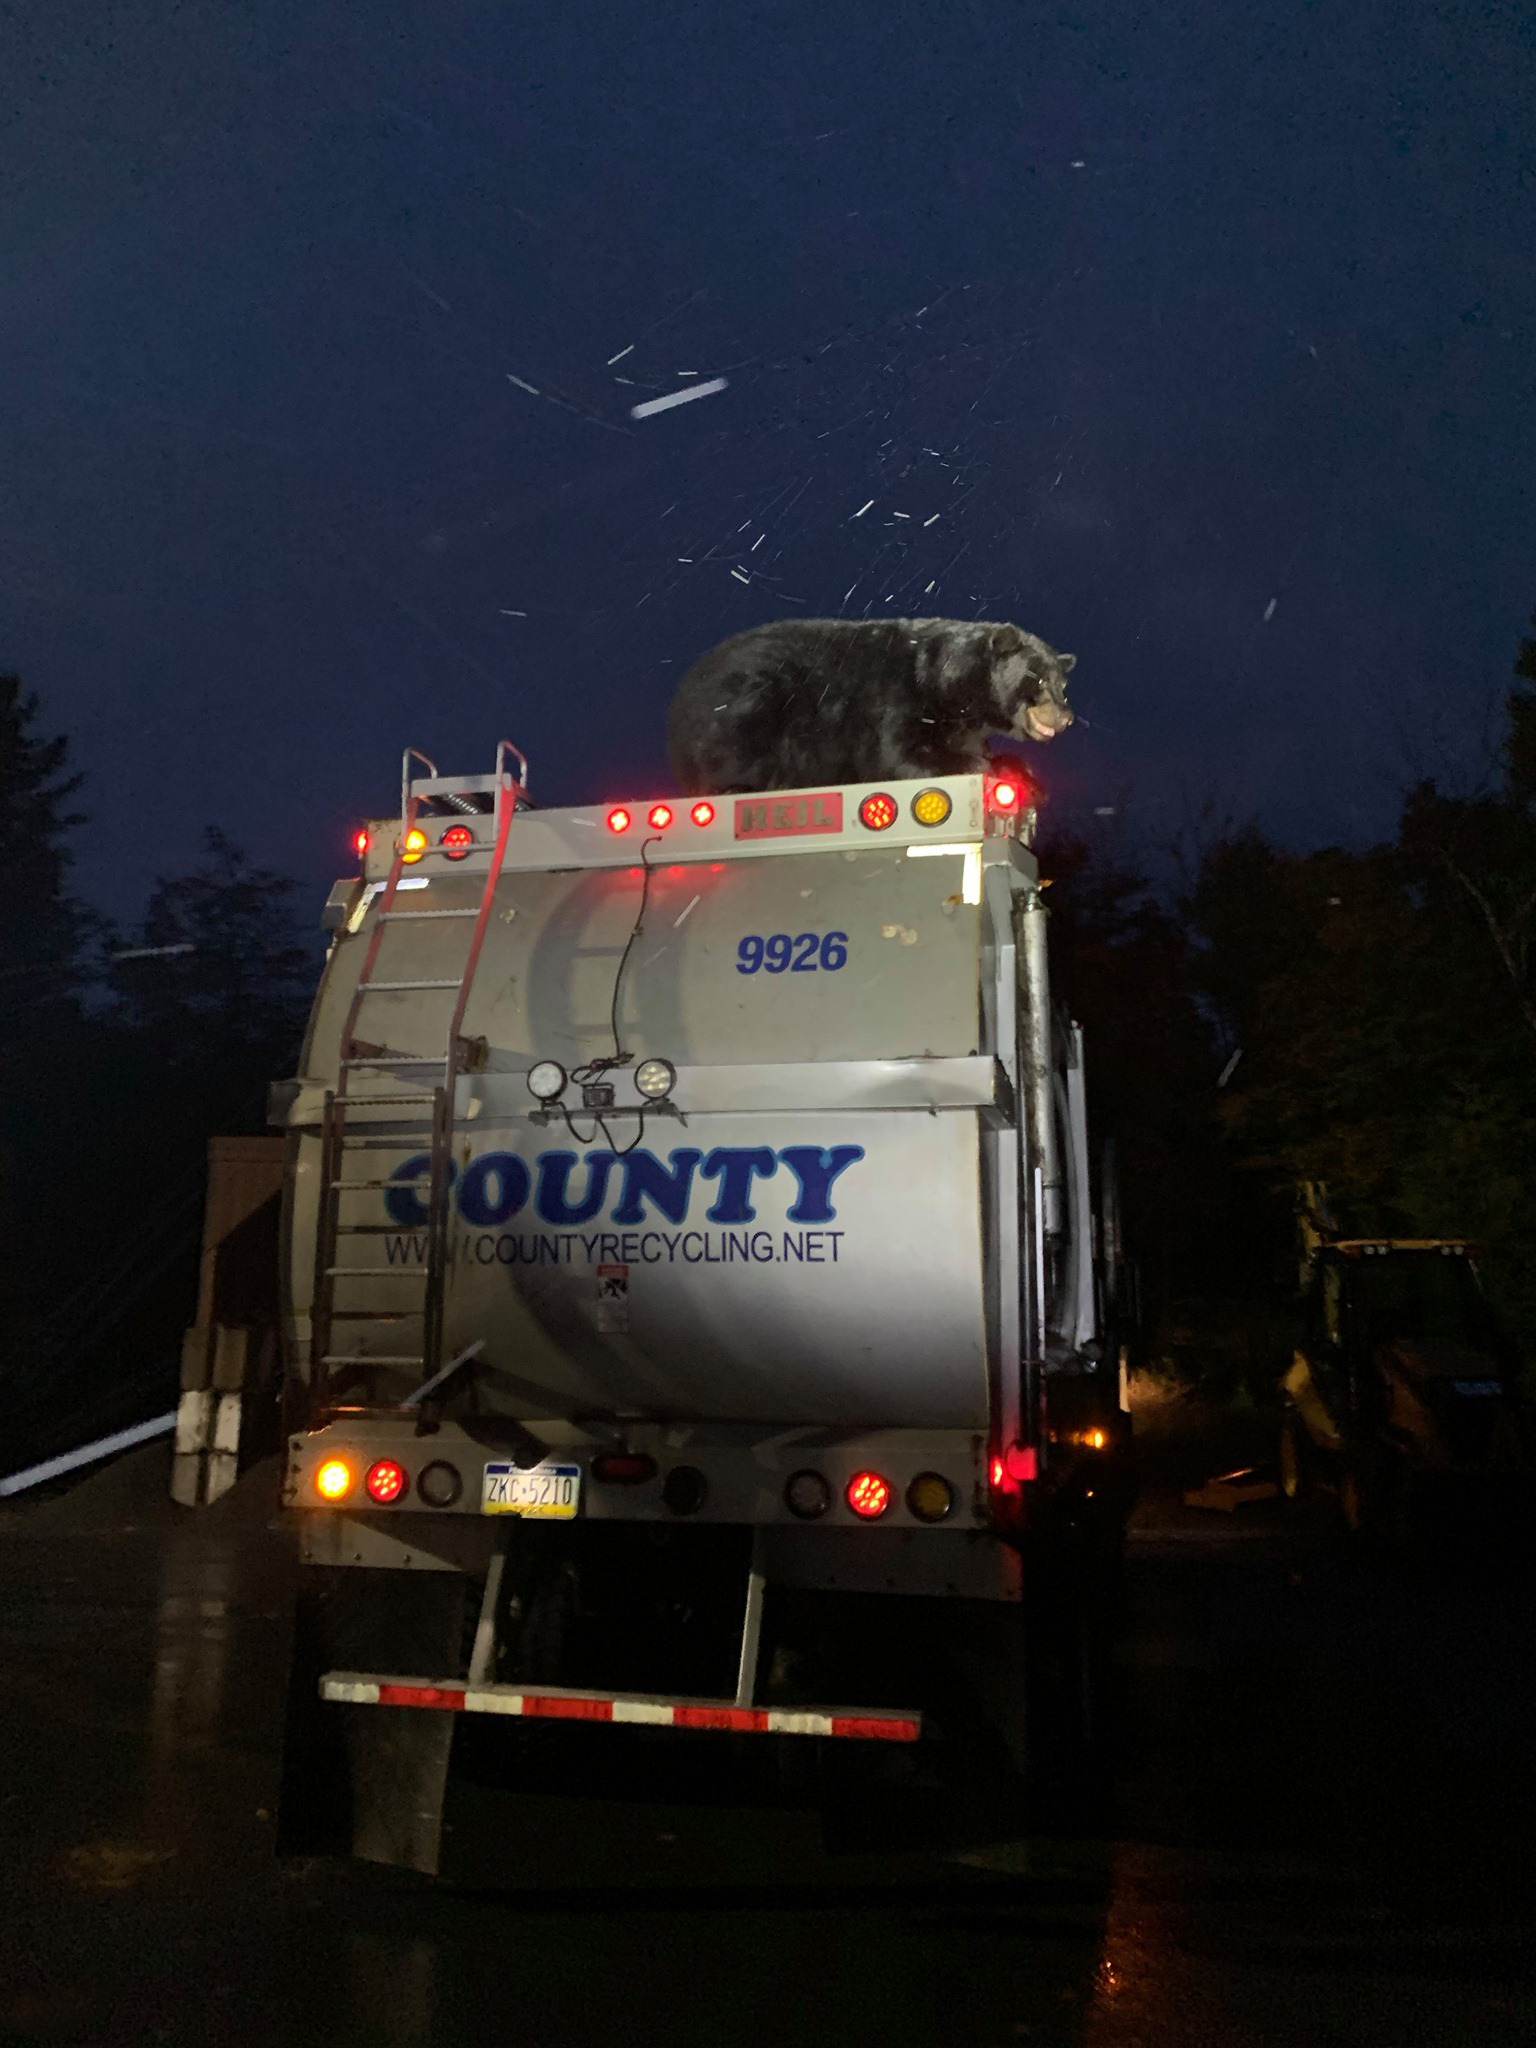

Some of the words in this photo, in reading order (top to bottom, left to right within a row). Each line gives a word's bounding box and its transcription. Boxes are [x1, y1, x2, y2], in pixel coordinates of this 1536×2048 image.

[741, 798, 834, 832] HEIL
[735, 931, 849, 975] 9926
[384, 1144, 865, 1228] COUNTY
